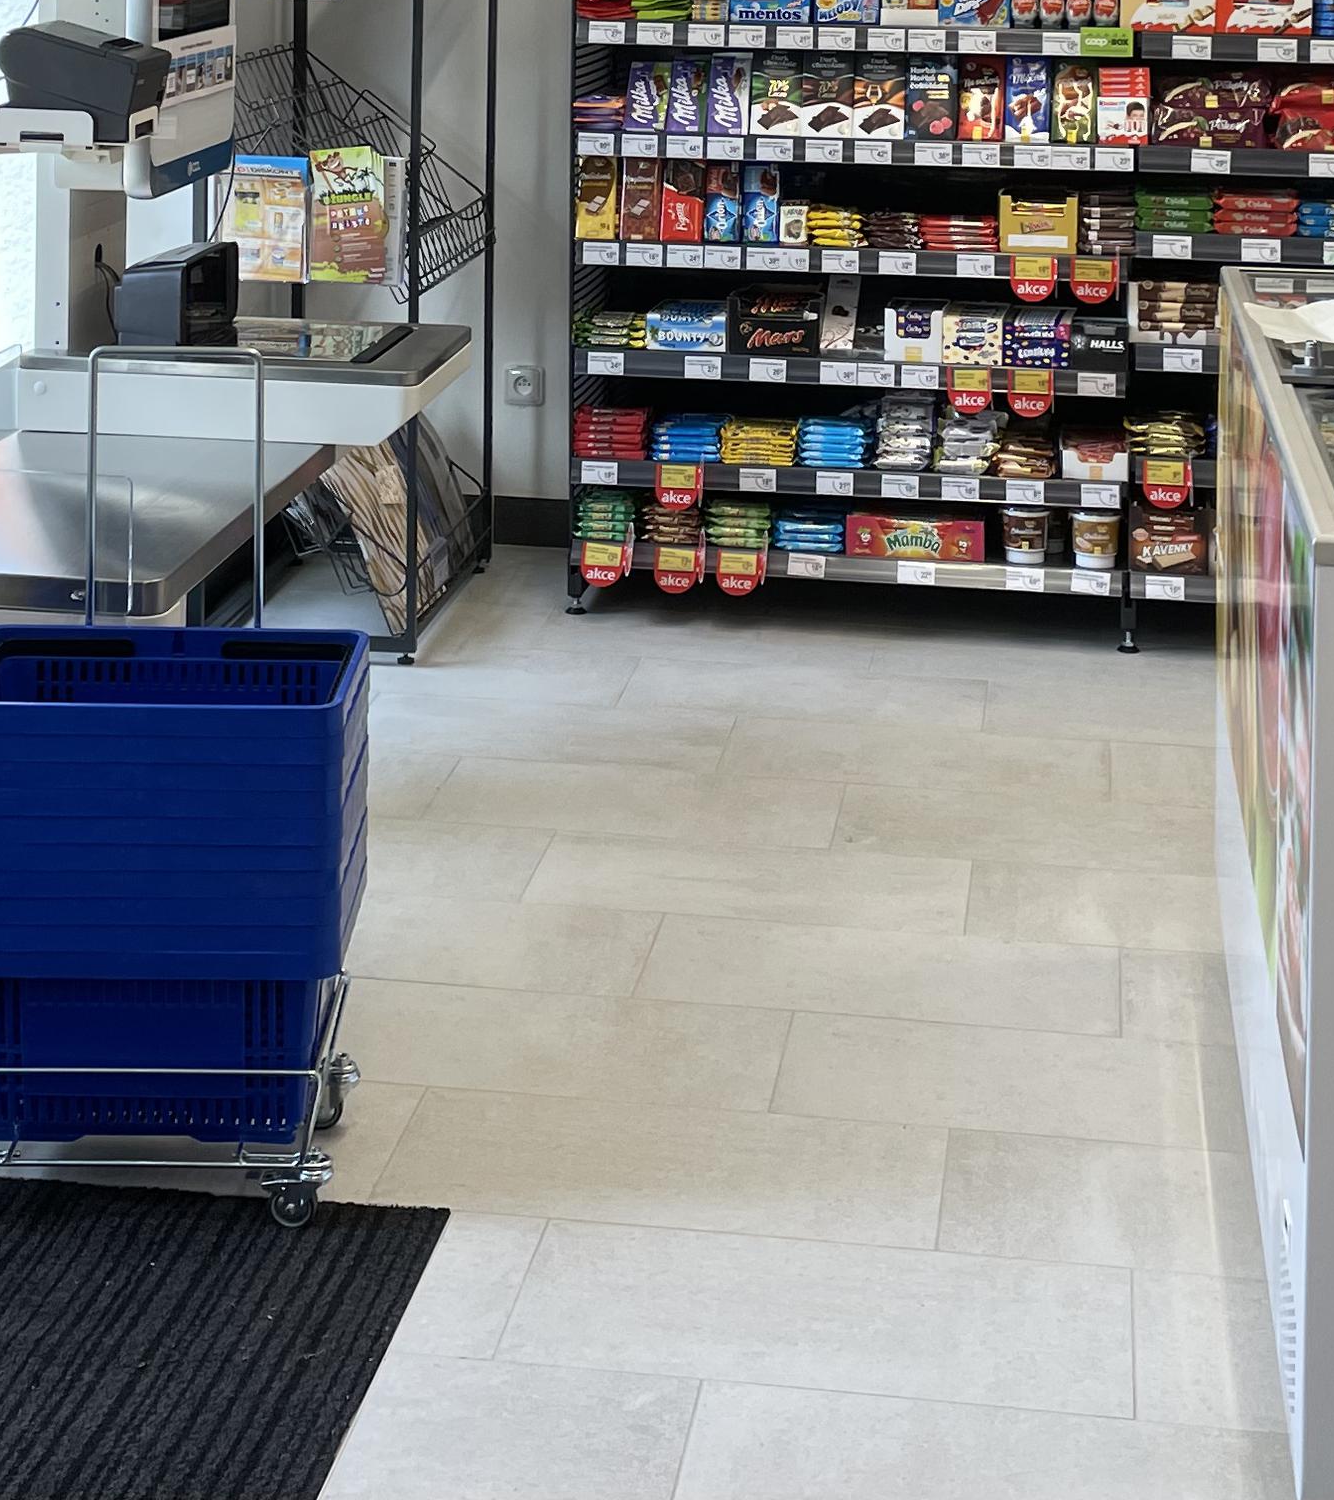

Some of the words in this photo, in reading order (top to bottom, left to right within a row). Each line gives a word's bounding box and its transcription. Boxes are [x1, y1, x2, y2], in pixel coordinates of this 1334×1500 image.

[738, 6, 802, 22] mentos
[631, 73, 651, 125] Milka
[672, 75, 695, 127] Milka
[711, 79, 737, 130] Milka
[1016, 281, 1049, 297] akce
[1076, 282, 1109, 298] akce
[658, 328, 709, 343] BOUNTY
[747, 327, 806, 349] Mars
[1089, 337, 1126, 351] HALLS
[954, 391, 986, 408] akce
[1013, 396, 1046, 412] akce
[661, 490, 693, 506] akce
[1148, 488, 1181, 504] akce
[885, 531, 941, 554] Mamba
[585, 566, 617, 583] akce
[660, 573, 691, 589] akce
[722, 575, 754, 591] akce
